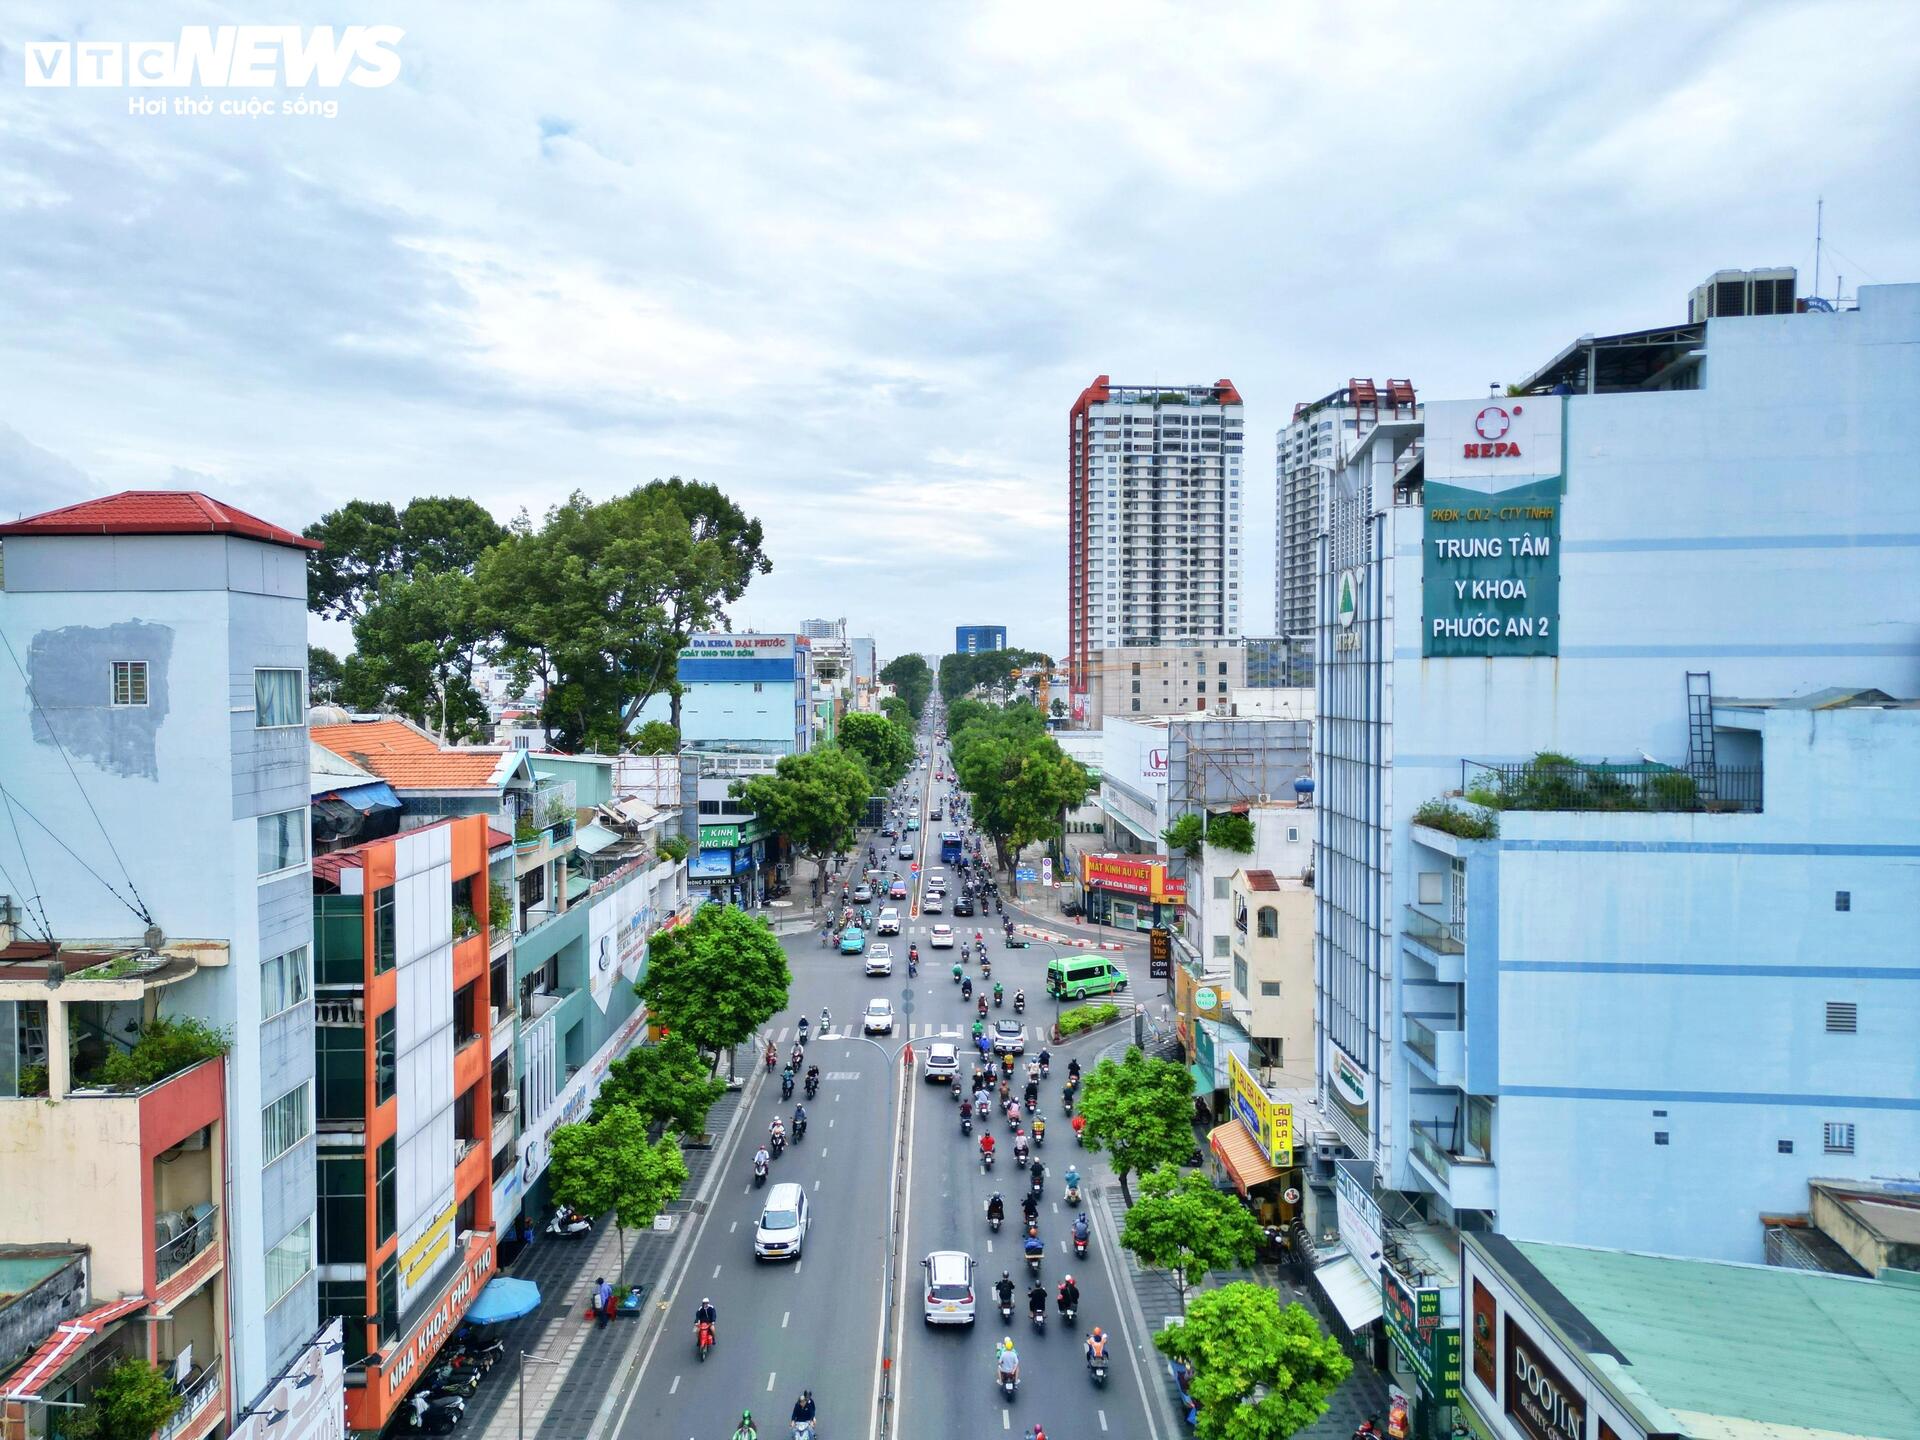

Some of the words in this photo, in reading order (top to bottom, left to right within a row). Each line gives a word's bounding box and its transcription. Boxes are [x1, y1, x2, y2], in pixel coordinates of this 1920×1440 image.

[1463, 442, 1522, 458] HEPA
[1466, 508, 1482, 521] CN
[1499, 507, 1522, 520] CTY
[1525, 506, 1554, 519] TNHH
[1435, 538, 1502, 558] TRUNG
[1508, 532, 1550, 557] TÂM
[1455, 581, 1467, 599] Y
[1472, 580, 1527, 599] KHOA
[1433, 612, 1500, 637] PHƯỚC
[1505, 617, 1533, 637] AN
[1538, 616, 1549, 636] 2
[708, 639, 733, 648] KHOA
[389, 1347, 415, 1394] NHA
[417, 1303, 448, 1356] KHOA
[451, 1266, 472, 1312] PHÚ
[1515, 1345, 1583, 1440] DOOJIN
